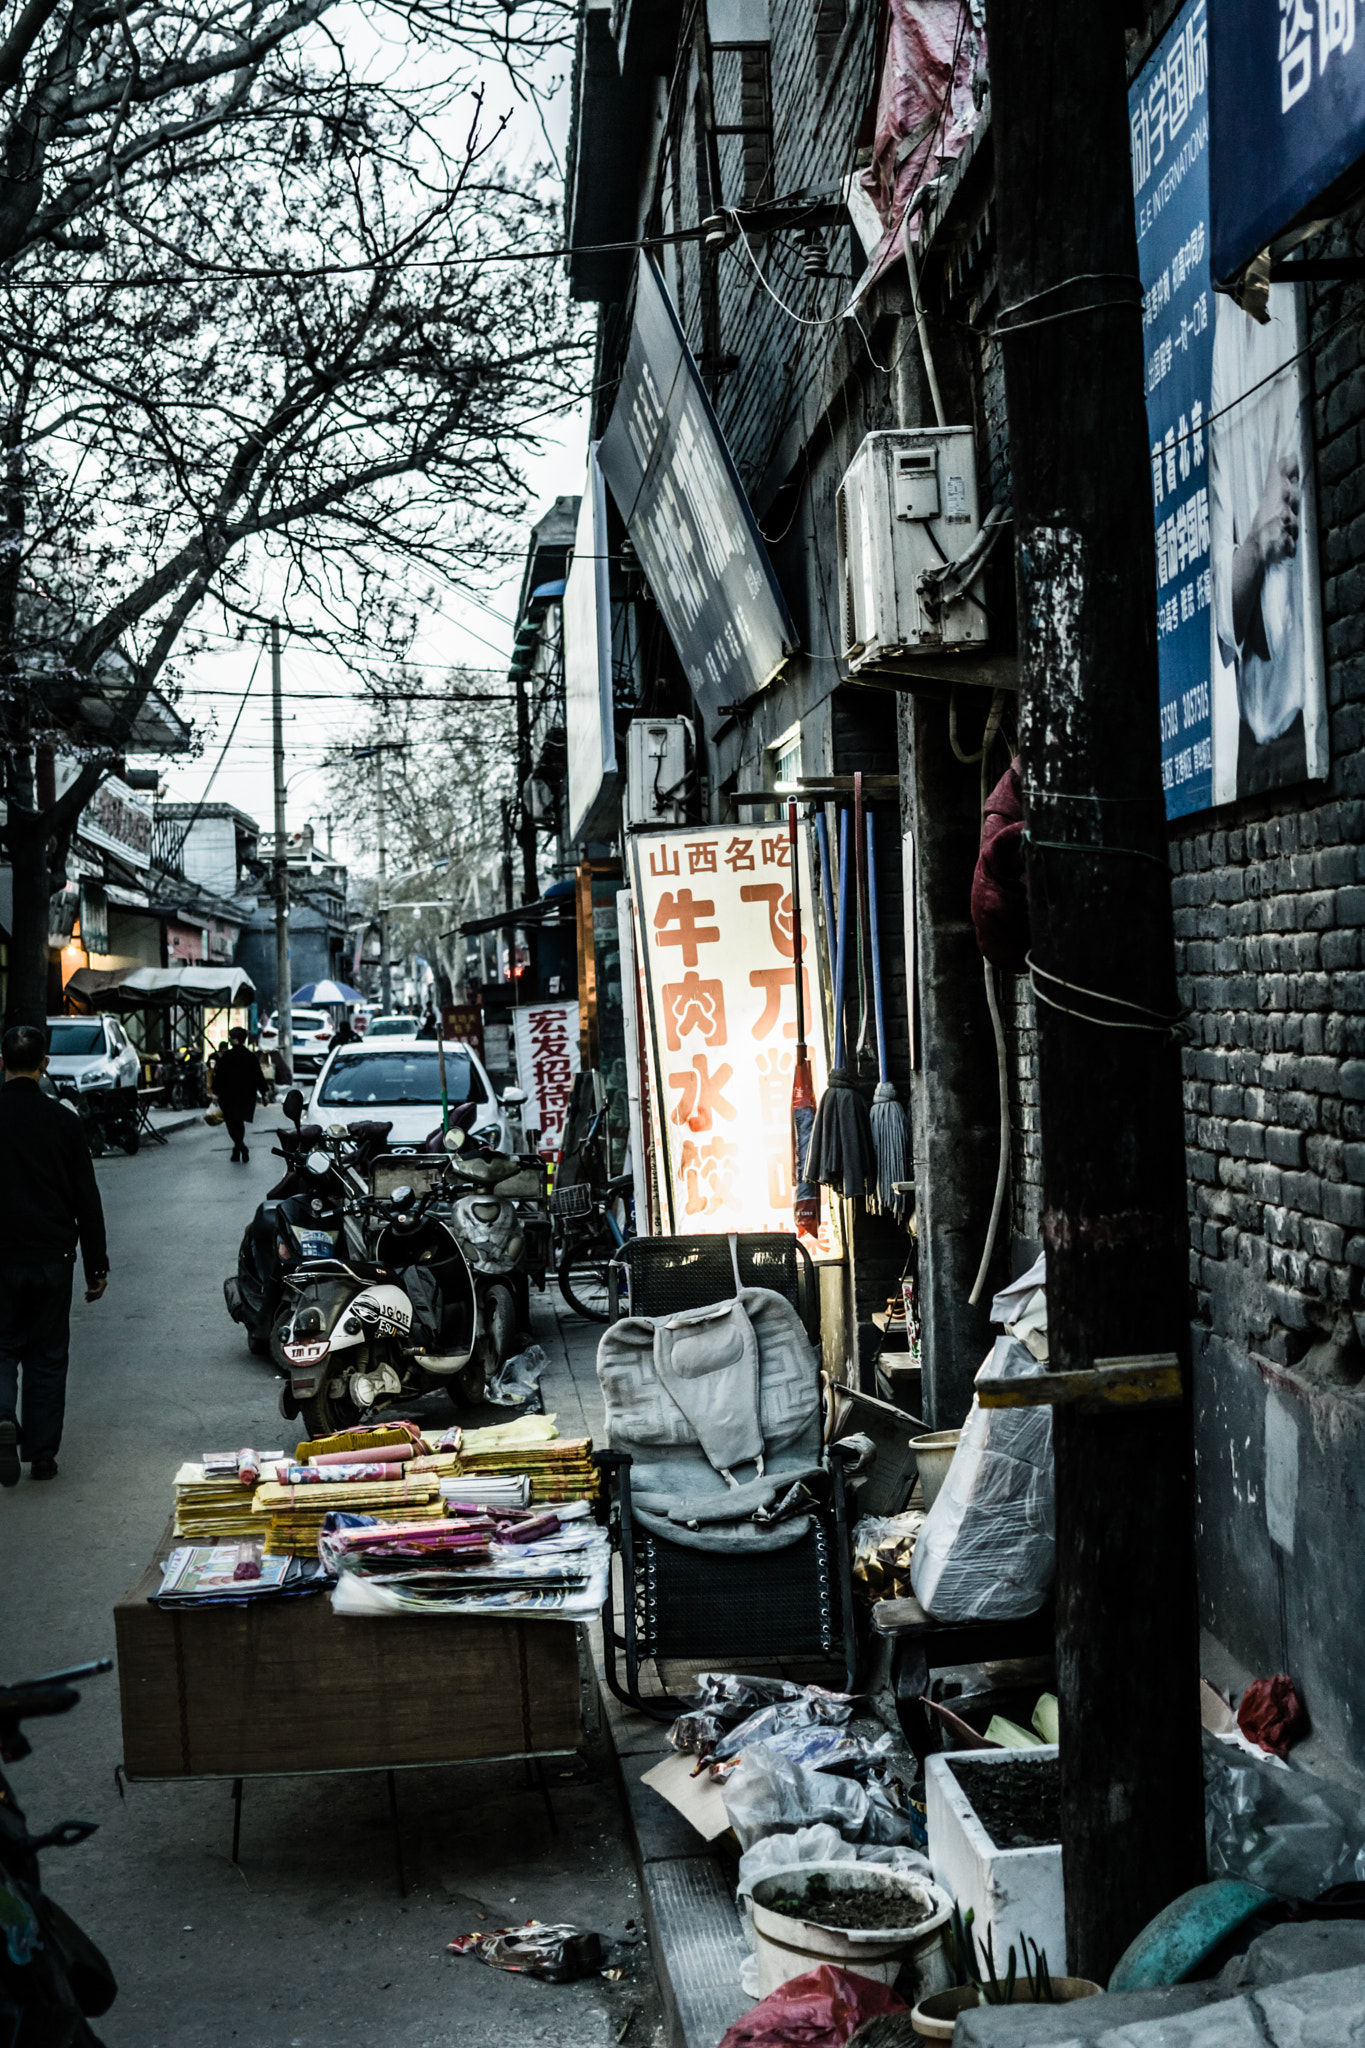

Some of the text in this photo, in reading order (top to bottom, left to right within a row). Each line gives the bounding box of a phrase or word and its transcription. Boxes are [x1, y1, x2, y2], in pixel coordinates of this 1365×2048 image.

[649, 833, 792, 877] 山西名吃
[528, 1009, 571, 1134] 宏发招待所
[653, 888, 742, 1215] 牛肉水饺
